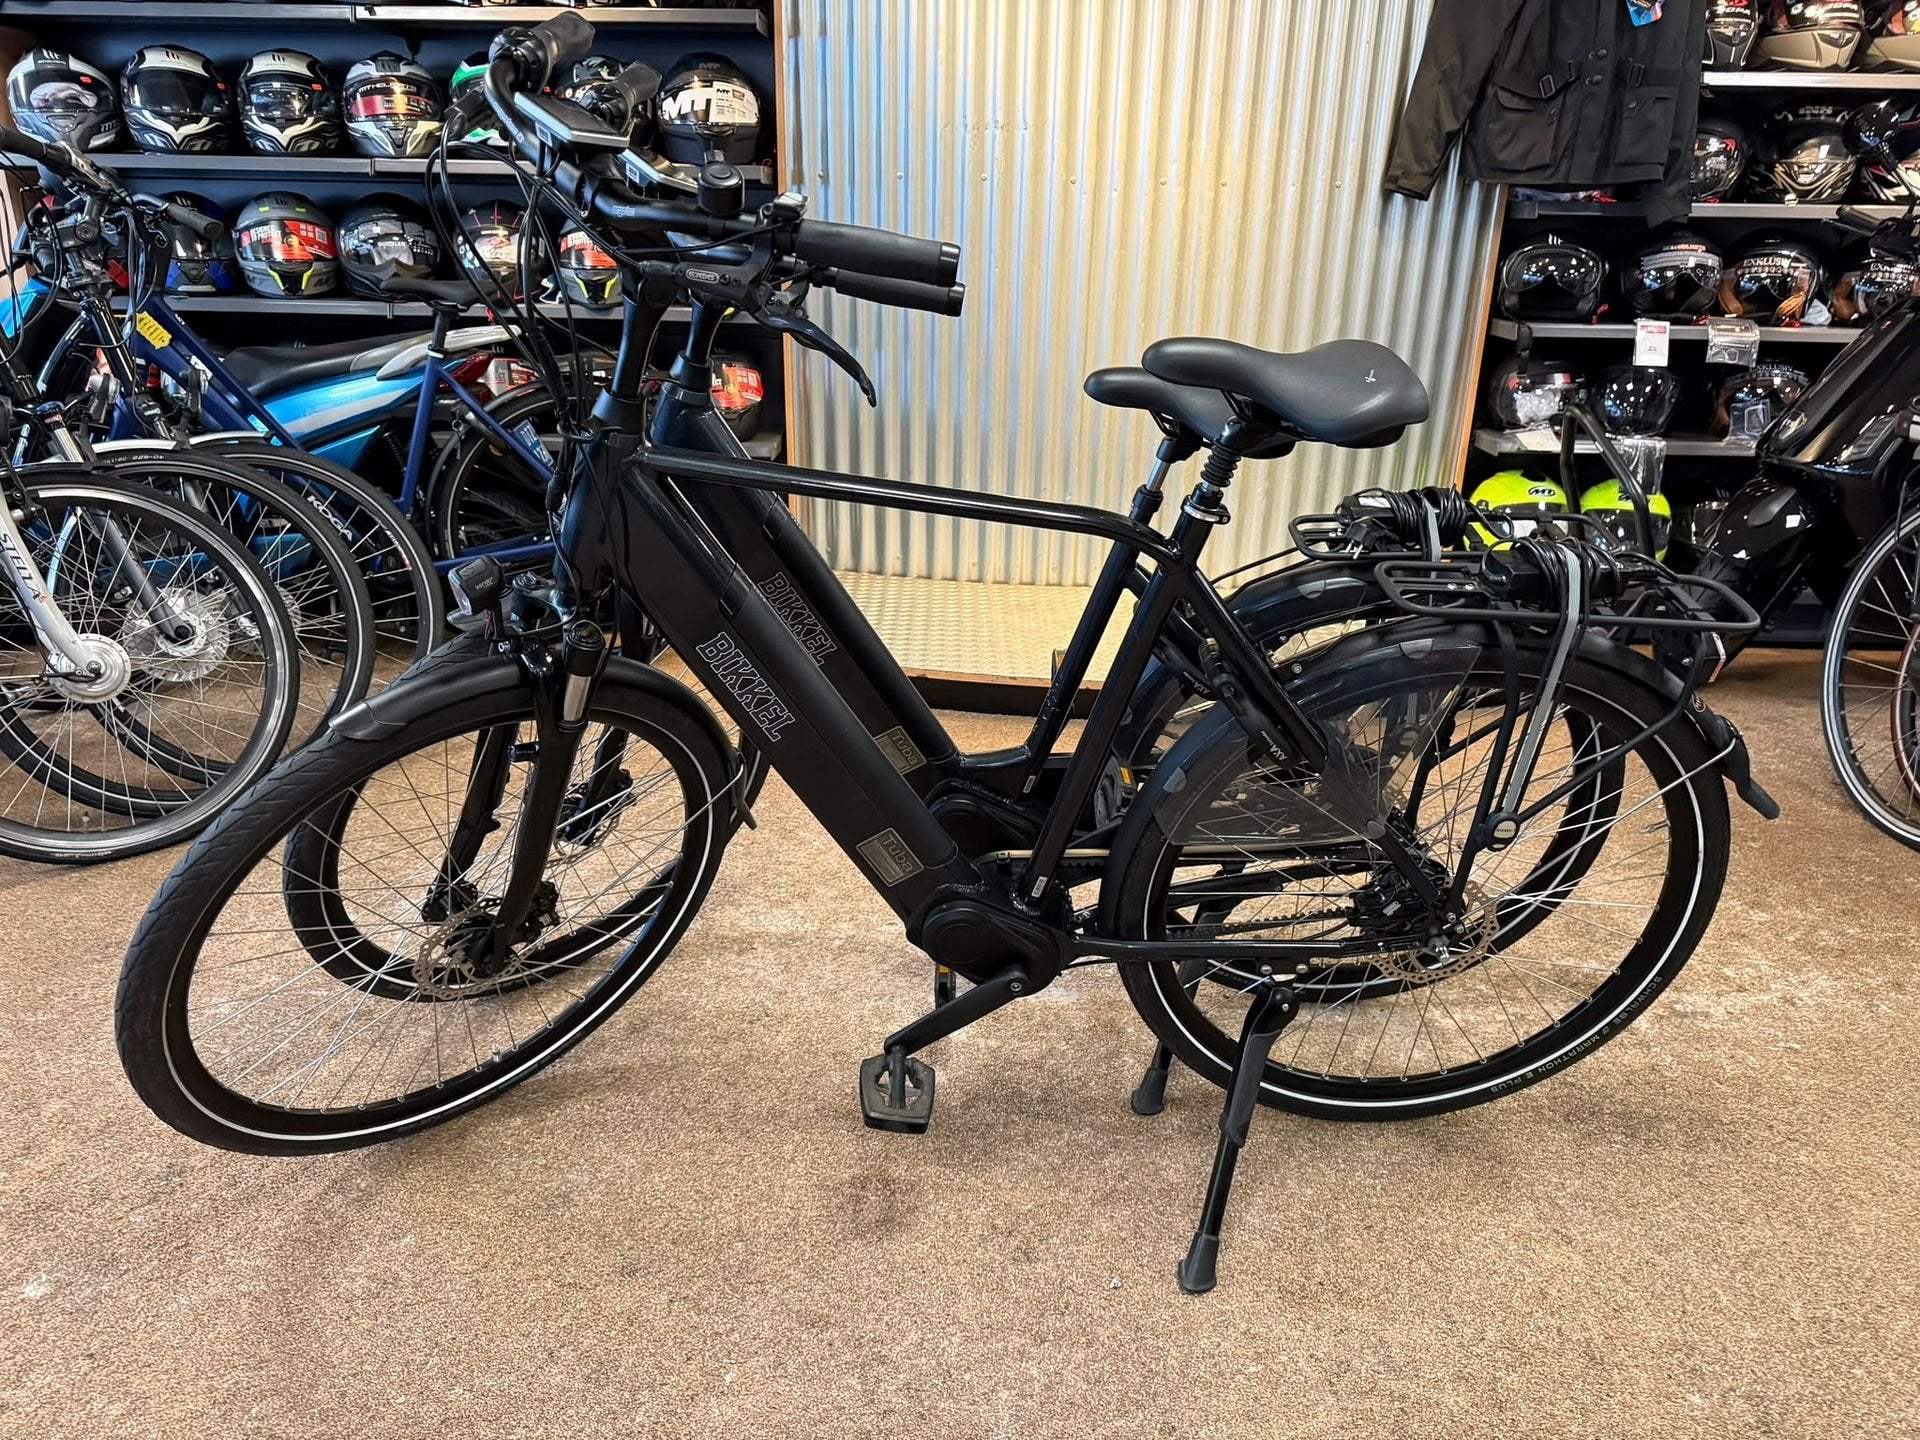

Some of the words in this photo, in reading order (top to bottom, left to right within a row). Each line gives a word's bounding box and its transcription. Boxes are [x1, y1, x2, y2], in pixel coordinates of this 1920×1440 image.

[662, 87, 713, 120] MT
[306, 494, 353, 542] KOGA
[2, 532, 42, 601] STELLA
[757, 571, 838, 667] BIKKEL
[696, 631, 796, 743] BIKKEL
[892, 730, 918, 765] Tuba
[1270, 744, 1288, 761] AXA
[883, 833, 913, 873] Tuba
[1612, 975, 1663, 1025] SCHWALBE
[1537, 1034, 1601, 1075] MARATHON
[1489, 1077, 1523, 1094] PLUS
